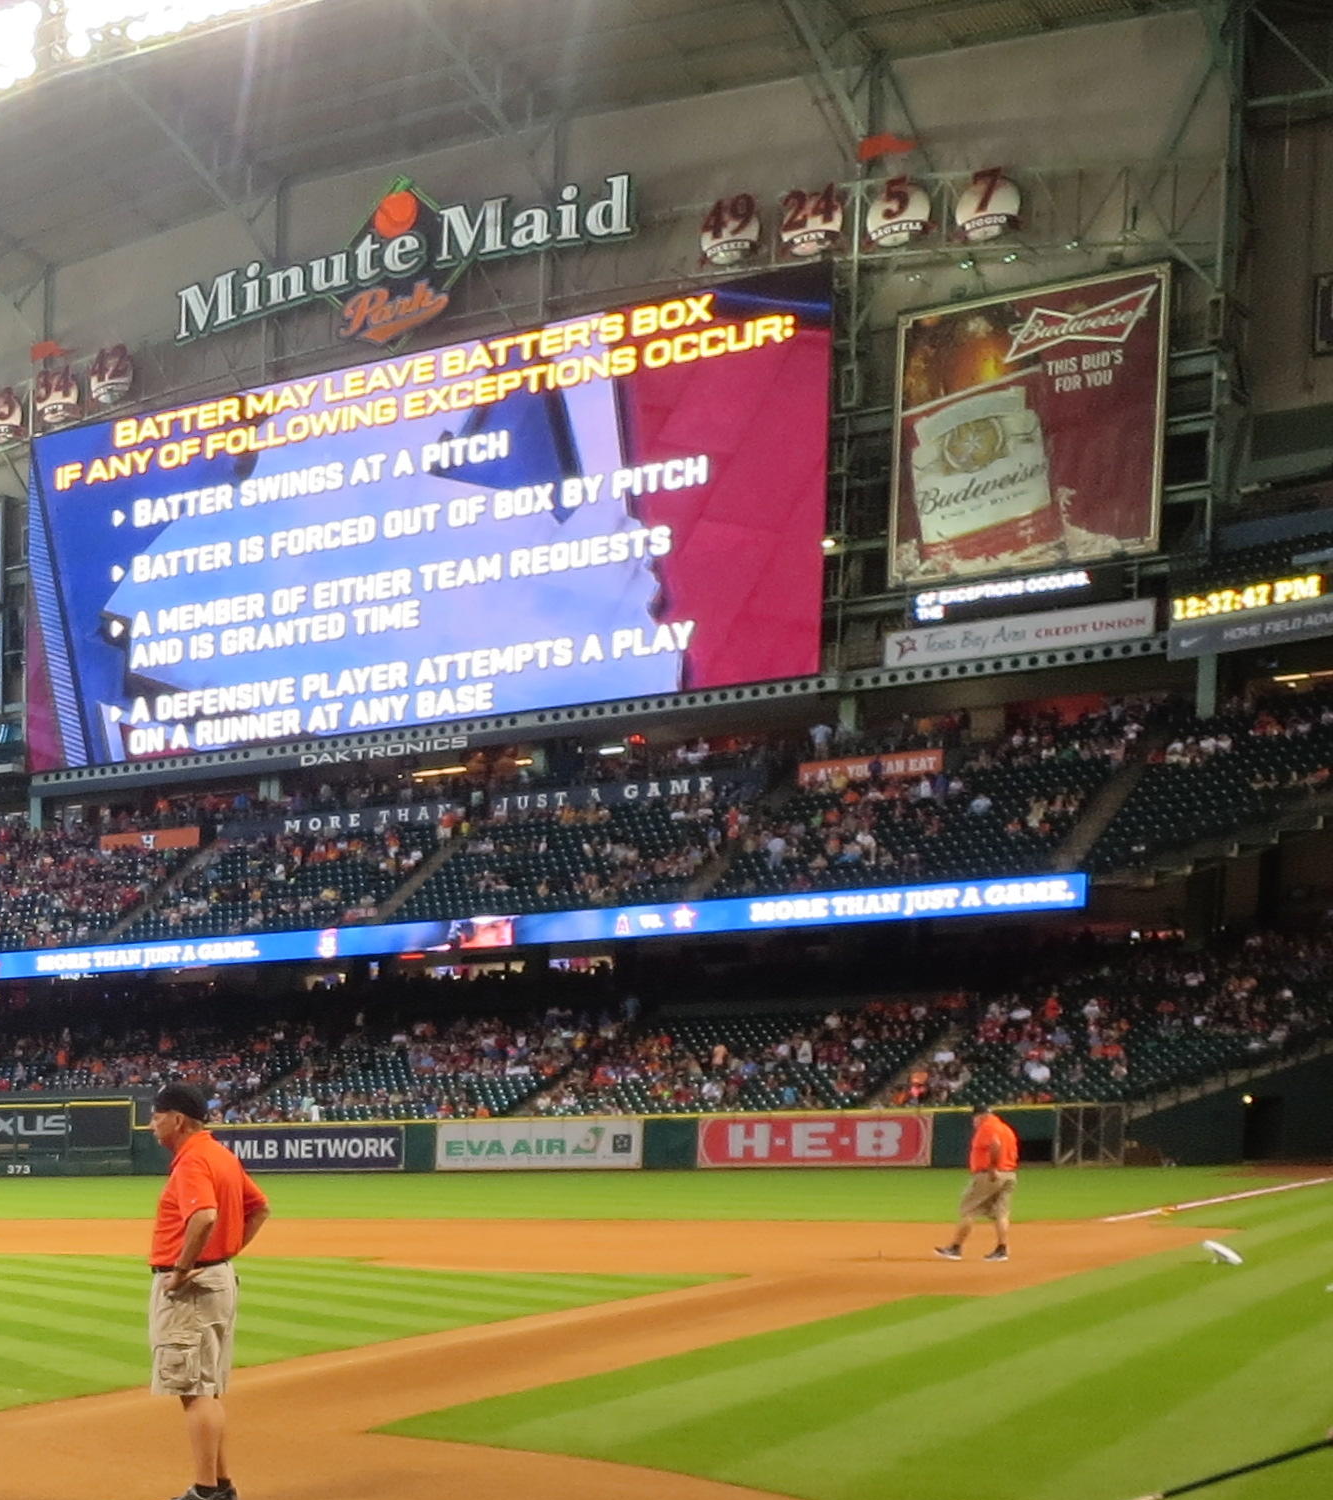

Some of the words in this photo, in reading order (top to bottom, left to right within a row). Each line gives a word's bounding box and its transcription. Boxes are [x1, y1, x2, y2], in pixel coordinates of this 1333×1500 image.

[783, 182, 838, 231] 24
[882, 175, 909, 219] 5
[972, 167, 1001, 212] 7
[701, 194, 755, 238] 49
[175, 231, 420, 342] Minute
[436, 174, 631, 261] Maid
[340, 280, 449, 343] Park
[1008, 306, 1148, 344] Budweiser
[113, 397, 240, 447] BATTER
[245, 380, 318, 419] MAY
[324, 356, 437, 402] LEAVE
[440, 314, 624, 378] BATTER'S
[632, 294, 716, 338] BOX
[1047, 357, 1077, 376] THIS
[1082, 349, 1123, 370] BUD'S
[1055, 375, 1081, 393] FOR
[1086, 370, 1112, 387] YOU
[55, 461, 86, 491] IF
[86, 447, 155, 485] ANY
[158, 436, 202, 469] OF
[206, 404, 398, 458] FOLLOWING
[403, 347, 636, 418] EXCEPTIONS
[644, 315, 796, 369] OCCUR:
[133, 485, 233, 527] BATTER
[239, 461, 343, 509] SWINGS
[349, 454, 386, 487] AT
[392, 448, 413, 477] A
[422, 430, 509, 473] PITCH
[132, 542, 232, 583] BATTER
[239, 534, 265, 564] IS
[271, 516, 376, 558] FORCED
[383, 503, 446, 540] OUT
[448, 494, 486, 528] OF
[494, 482, 555, 521] BOX
[562, 473, 604, 508] BY
[611, 454, 709, 498] PITCH
[131, 611, 150, 639] A
[156, 593, 264, 633] MEMBER
[271, 586, 306, 613] OF
[313, 568, 412, 609] EITHER
[420, 552, 501, 591] TEAM
[509, 526, 672, 579] REQUESTS
[1172, 583, 1272, 621] 12:37:47
[1273, 574, 1323, 603] PM
[130, 638, 183, 669] AND
[190, 632, 215, 660] IS
[220, 611, 346, 655] GRANTED
[352, 600, 421, 636] TIME
[1034, 623, 1090, 639] CREDIT
[1092, 616, 1146, 632] UNION
[130, 697, 150, 724] A
[156, 677, 295, 722] DEFENSIVE
[302, 660, 408, 702] PLAYER
[416, 635, 574, 686] ATTEMPTS
[580, 634, 603, 662] A
[612, 621, 695, 658] PLAY
[130, 724, 166, 755] ON
[170, 721, 189, 748] A
[194, 709, 301, 748] RUNNER
[306, 706, 343, 733] AT
[349, 693, 410, 727] ANY
[416, 682, 494, 718] BASE
[300, 735, 468, 767] DAKTRONICS
[749, 898, 828, 922] MORE
[833, 893, 901, 916] THAN
[903, 888, 960, 916] JUST
[963, 887, 982, 908] A
[6, 1164, 31, 1175] 373
[234, 1139, 278, 1160] MLB
[284, 1137, 396, 1160] NETWORK
[445, 1139, 505, 1157] EVA
[510, 1138, 567, 1156] AIR
